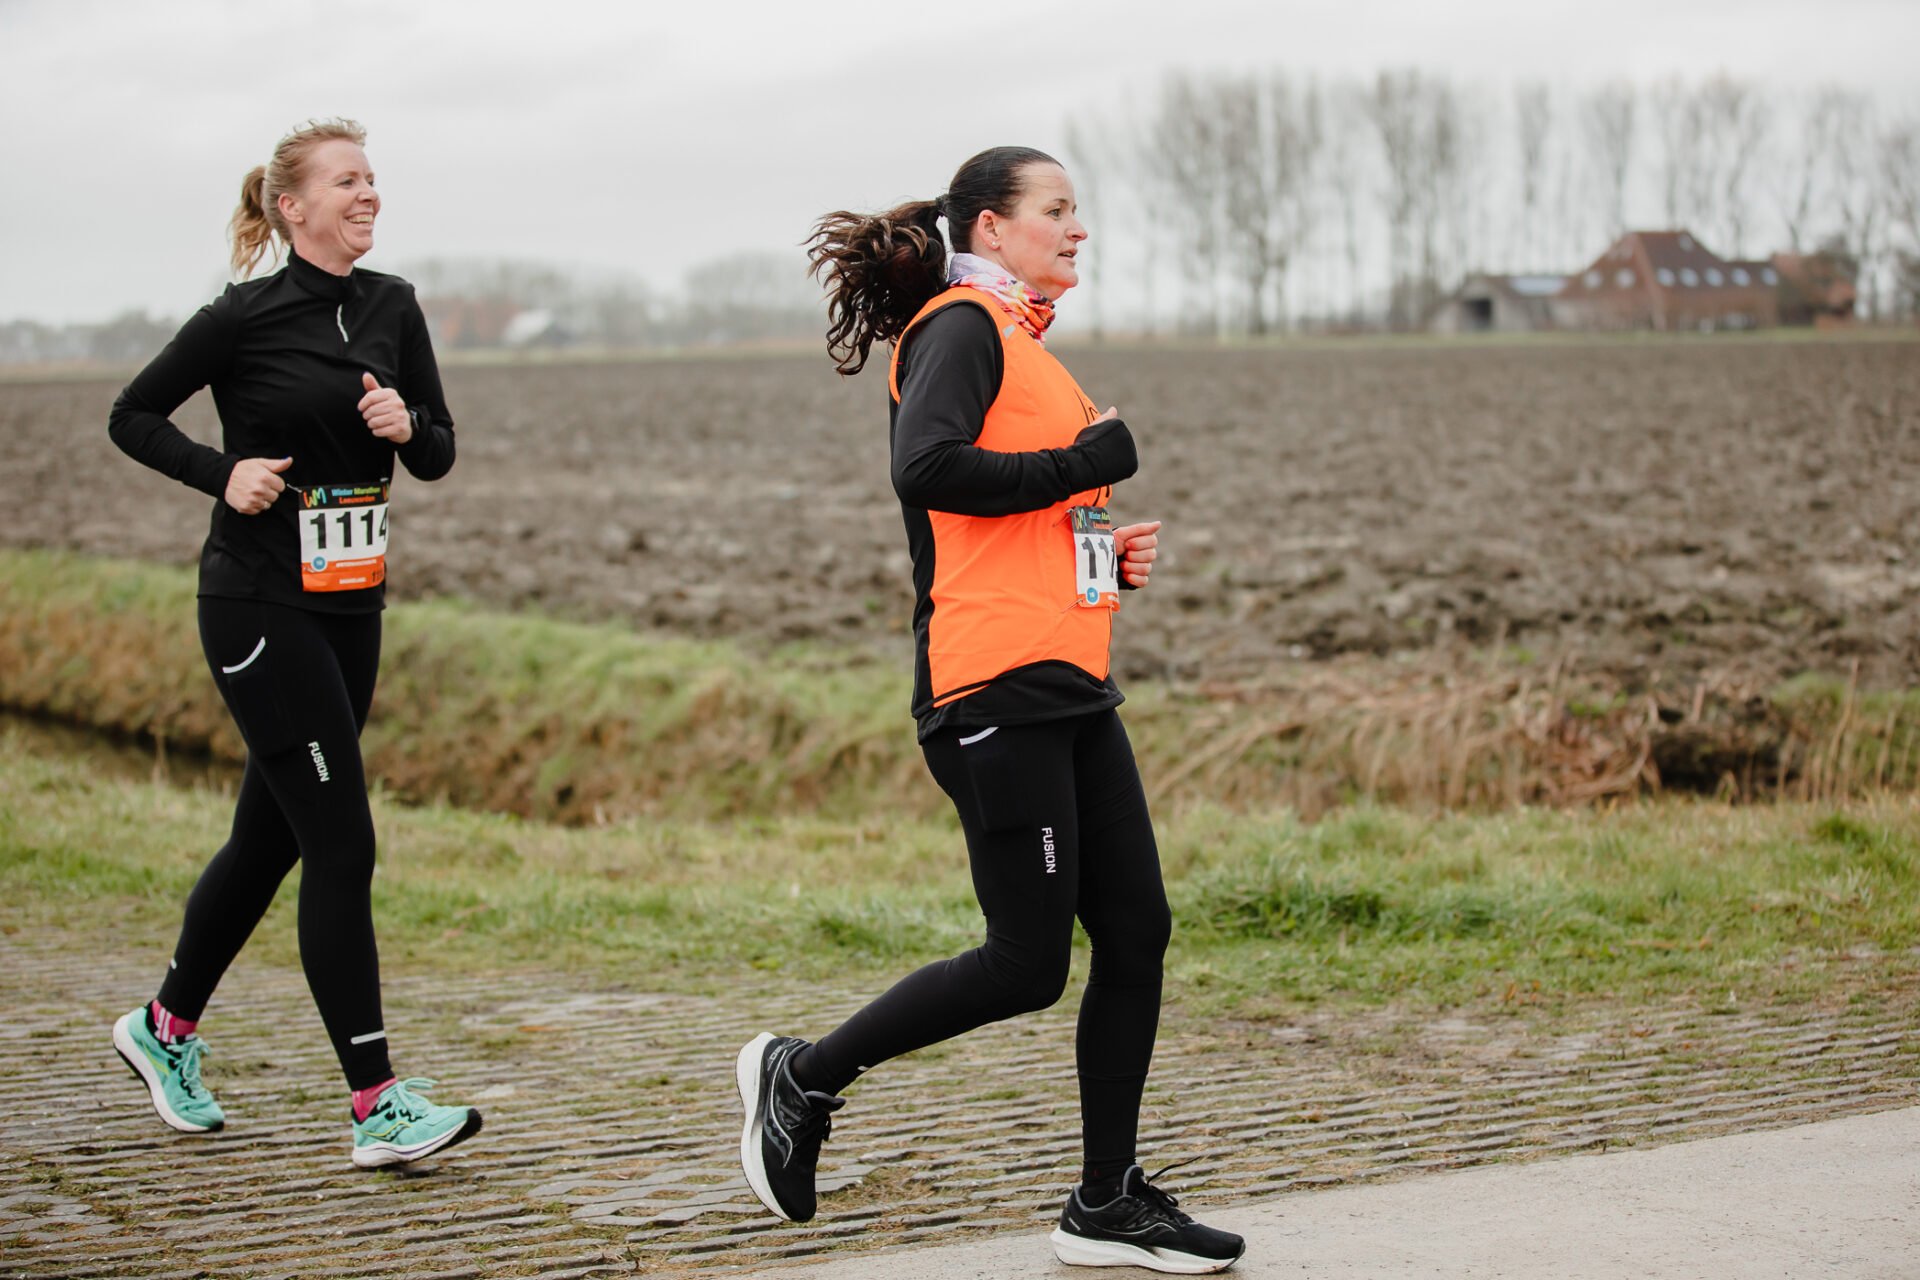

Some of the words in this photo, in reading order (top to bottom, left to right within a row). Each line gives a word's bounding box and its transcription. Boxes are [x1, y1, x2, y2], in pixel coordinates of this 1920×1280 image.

[310, 506, 388, 549] 1114
[308, 741, 330, 782] FUSION
[1041, 827, 1056, 873] FUSION
